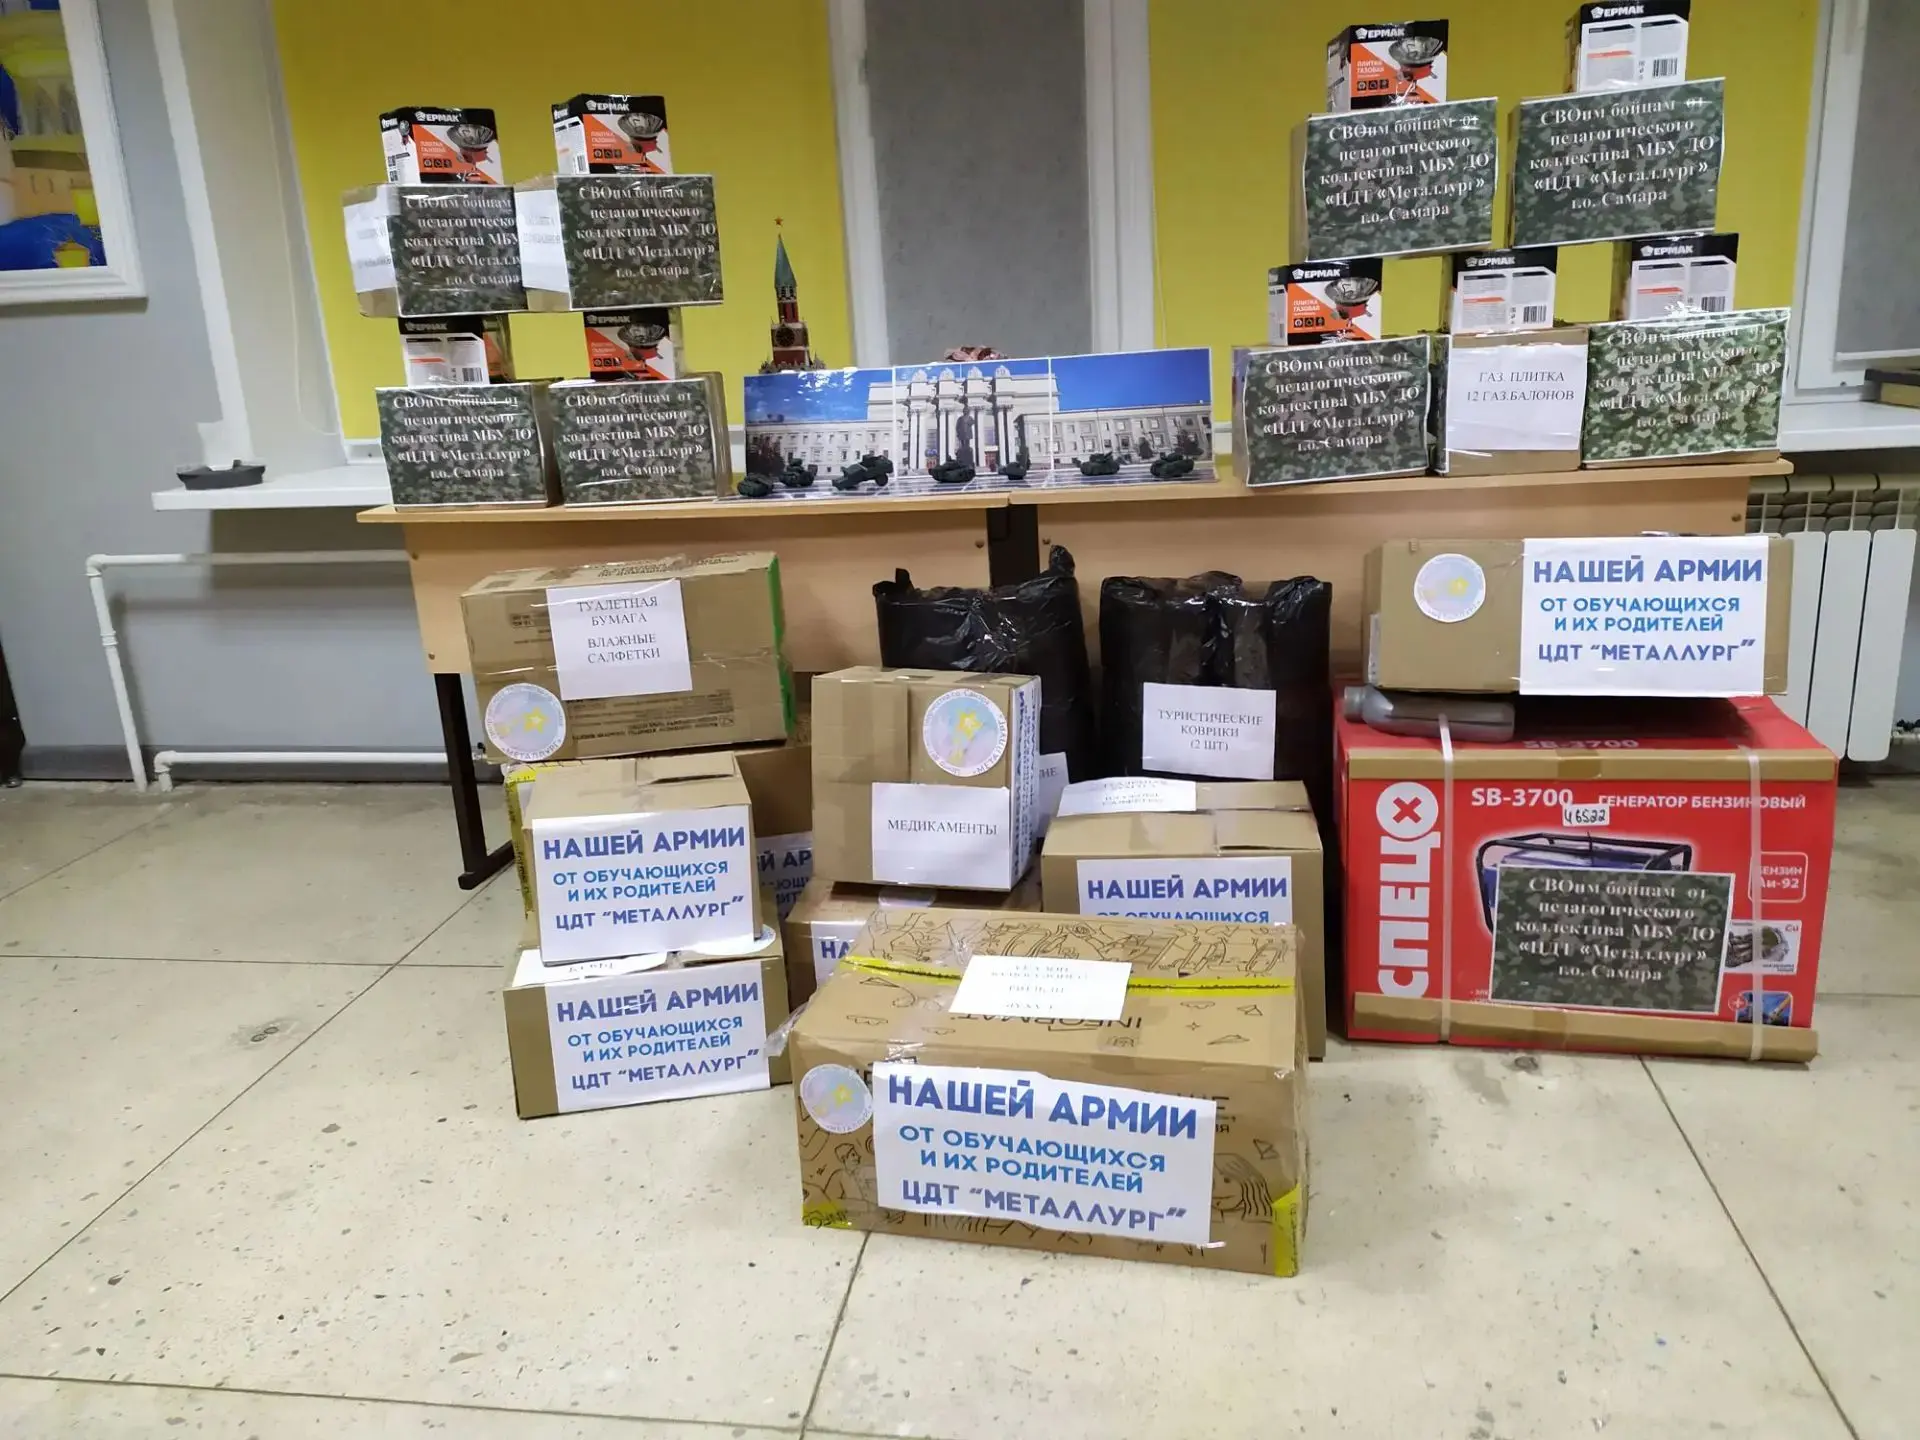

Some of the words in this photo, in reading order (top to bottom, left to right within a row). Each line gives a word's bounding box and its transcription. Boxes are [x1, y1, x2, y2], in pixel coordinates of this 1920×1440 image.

[1604, 5, 1644, 16] ЕРМАК
[1368, 28, 1404, 38] ЕРМАК
[427, 114, 459, 122] ЕРМАК
[1550, 120, 1694, 146] педагогического
[1340, 137, 1470, 161] педагогического
[1530, 149, 1629, 169] коллектива
[1636, 141, 1677, 156] МБУ
[1320, 165, 1413, 185] коллектива
[1419, 158, 1456, 173] МБУ
[1602, 190, 1667, 206] Самара
[1389, 205, 1449, 221] Самара
[1654, 245, 1693, 254] ЕРМАК
[1478, 257, 1515, 266] ЕРМАК
[641, 265, 689, 278] Самара
[1304, 269, 1340, 279] ЕРМАК
[1511, 371, 1565, 382] ПЛИТКА
[1467, 392, 1478, 401] 12
[454, 467, 504, 480] Самара
[624, 465, 675, 476] Самара
[1534, 555, 1644, 583] НАШЕЙ
[1654, 559, 1762, 582] АРМИИ
[577, 596, 658, 612] ТУАЛЕТНАЯ
[1540, 597, 1566, 613] ОТ
[1573, 596, 1740, 615] ОБУЧАЮЩИХСЯ
[591, 612, 647, 627] БУМАГА
[1554, 617, 1566, 631] И
[1573, 617, 1598, 631] ИХ
[1604, 613, 1724, 633] РОДИТЕЛЕЙ
[587, 633, 656, 649] ВЛАЖНЫЕ
[587, 648, 660, 664] САЛФЕТКИ
[1539, 644, 1583, 663] ЦДТ
[1158, 709, 1263, 725] ТУРИСТИЧЕСКИЕ
[1181, 725, 1239, 737] КОВРИКИ
[1191, 740, 1200, 749] (2
[1205, 740, 1228, 751] ШТ)
[1472, 788, 1573, 807] SB-3700
[1599, 795, 1688, 808] ГЕНЕРАТОР
[888, 818, 997, 836] МЕДИКАМЕНТЫ
[543, 830, 643, 860] НАШЕЙ
[653, 827, 744, 852] АРМИИ
[553, 872, 575, 885] ОТ
[584, 861, 728, 883] ОБУЧАЮЩИХСЯ
[1759, 867, 1802, 876] ЕНЗИН
[568, 888, 579, 901] И
[584, 888, 607, 900] ИХ
[614, 876, 716, 899] РОДИТЕЛЕЙ
[1088, 875, 1184, 899] НАШЕЙ
[1193, 877, 1287, 898] АРМИИ
[556, 913, 595, 930] ЦДТ
[557, 990, 656, 1022] НАШЕЙ
[667, 982, 759, 1010] АРМИИ
[568, 1034, 590, 1047] ОТ
[598, 1016, 742, 1044] ОБУЧАЮЩИХСЯ
[583, 1051, 594, 1063] И
[600, 1049, 622, 1061] ИХ
[628, 1033, 730, 1058] РОДИТЕЛЕЙ
[572, 1072, 611, 1090] ЦДТ
[888, 1073, 1035, 1119] НАШЕЙ
[1049, 1092, 1197, 1140] АРМИИ
[899, 1125, 934, 1143] ОТ
[942, 1128, 1165, 1173] ОБУЧАЮЩИХСЯ
[921, 1151, 936, 1165] И
[944, 1152, 977, 1172] ИХ
[986, 1156, 1144, 1193] РОДИТЕЛЕЙ
[902, 1179, 956, 1206] ЦДТ
